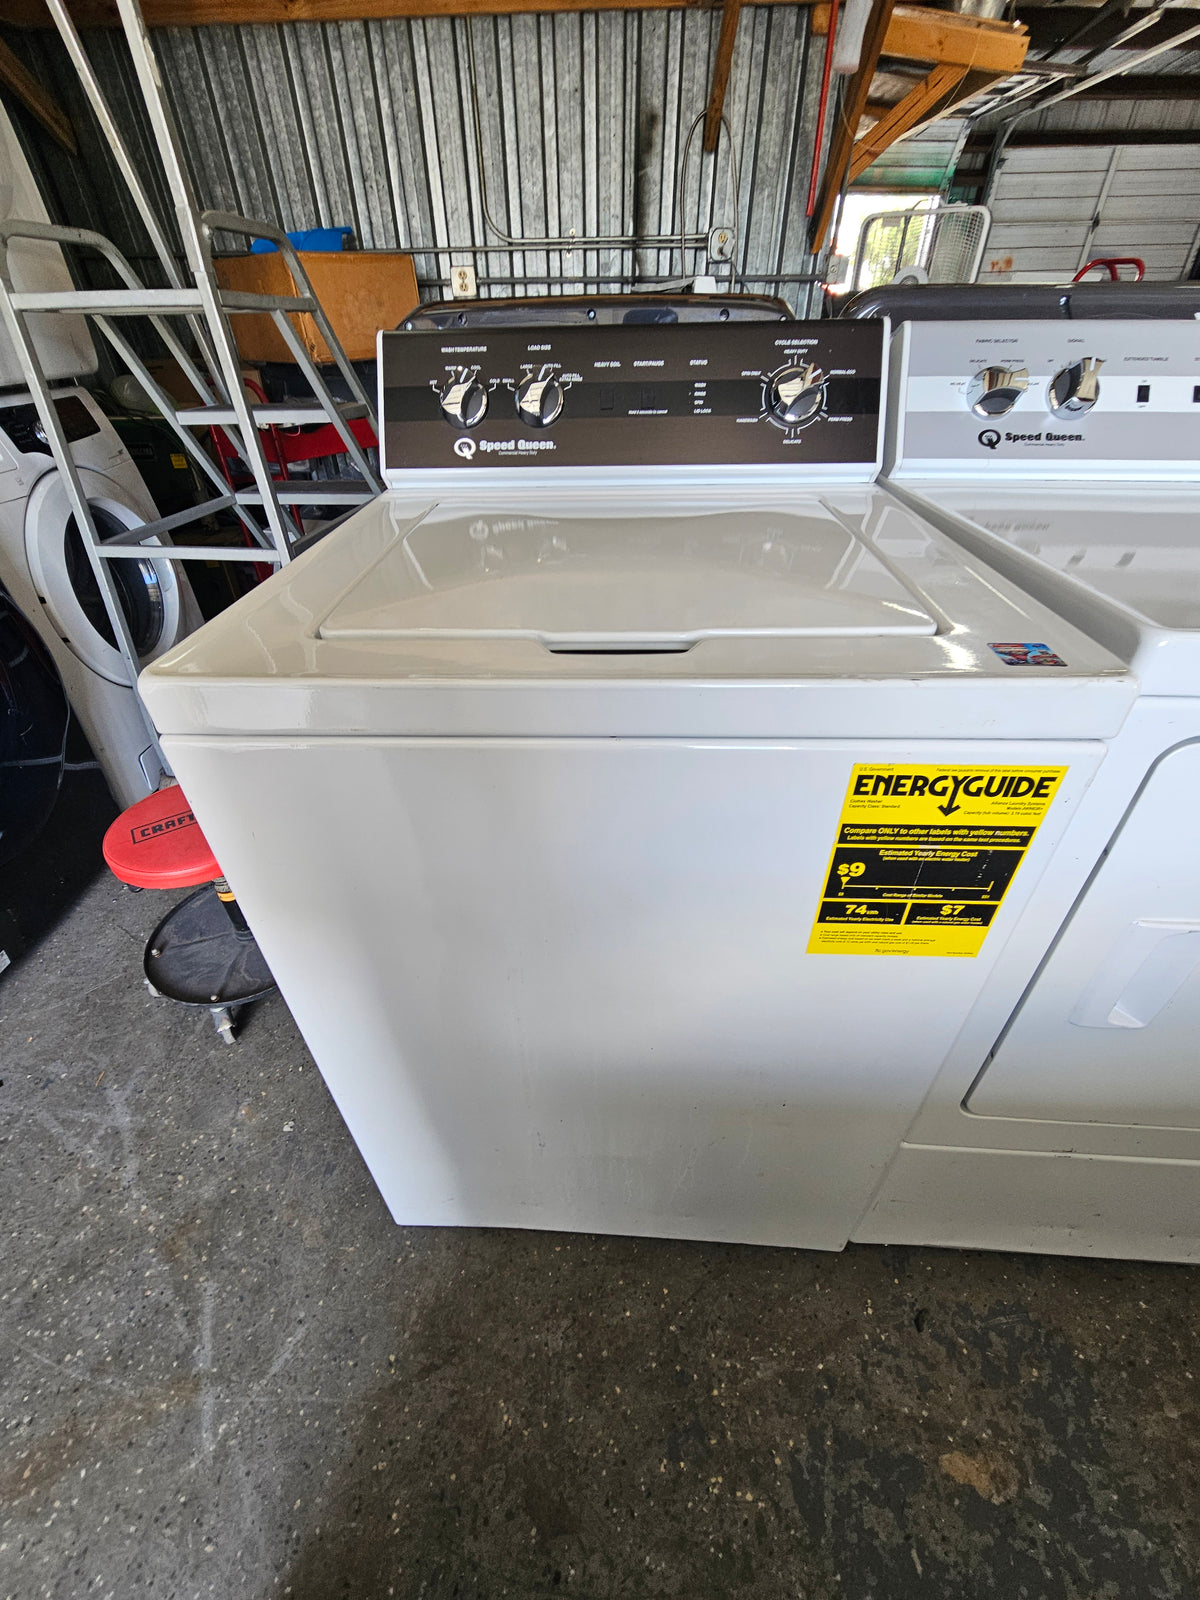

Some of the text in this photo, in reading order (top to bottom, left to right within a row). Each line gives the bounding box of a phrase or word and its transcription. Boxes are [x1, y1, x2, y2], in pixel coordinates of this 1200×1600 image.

[1005, 432, 1042, 443] Speed
[479, 440, 515, 453] Speed
[853, 775, 1058, 799] ENERGYGUIDE
[844, 826, 877, 835] Compare
[878, 827, 900, 835] ONLY
[929, 828, 952, 836] labels
[969, 829, 994, 837] yellow
[935, 850, 960, 858] Energy
[837, 861, 866, 877] $9
[845, 904, 867, 915] 74
[940, 904, 966, 916] $7
